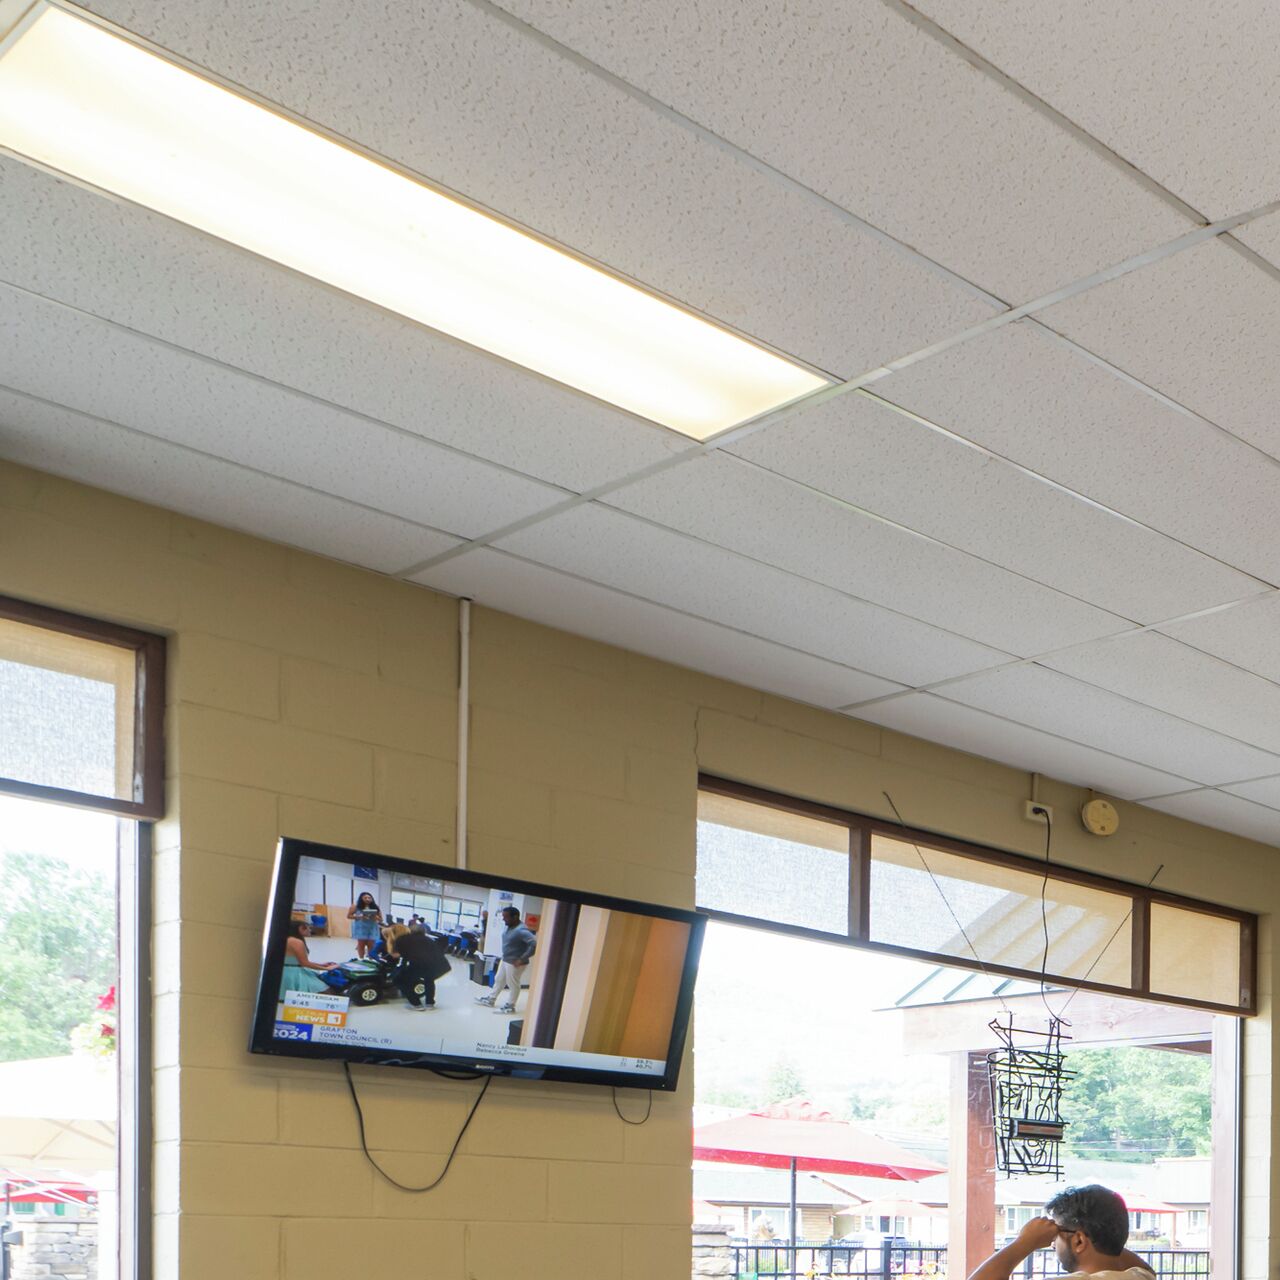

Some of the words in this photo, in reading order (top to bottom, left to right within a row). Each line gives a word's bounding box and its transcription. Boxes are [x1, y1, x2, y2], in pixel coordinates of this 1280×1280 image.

[296, 993, 340, 1001] AMSTERDAM
[295, 1014, 326, 1024] NEWS
[320, 1026, 358, 1034] GRAFTON
[320, 1032, 343, 1040] TOWN
[345, 1034, 379, 1043] COUNCIL
